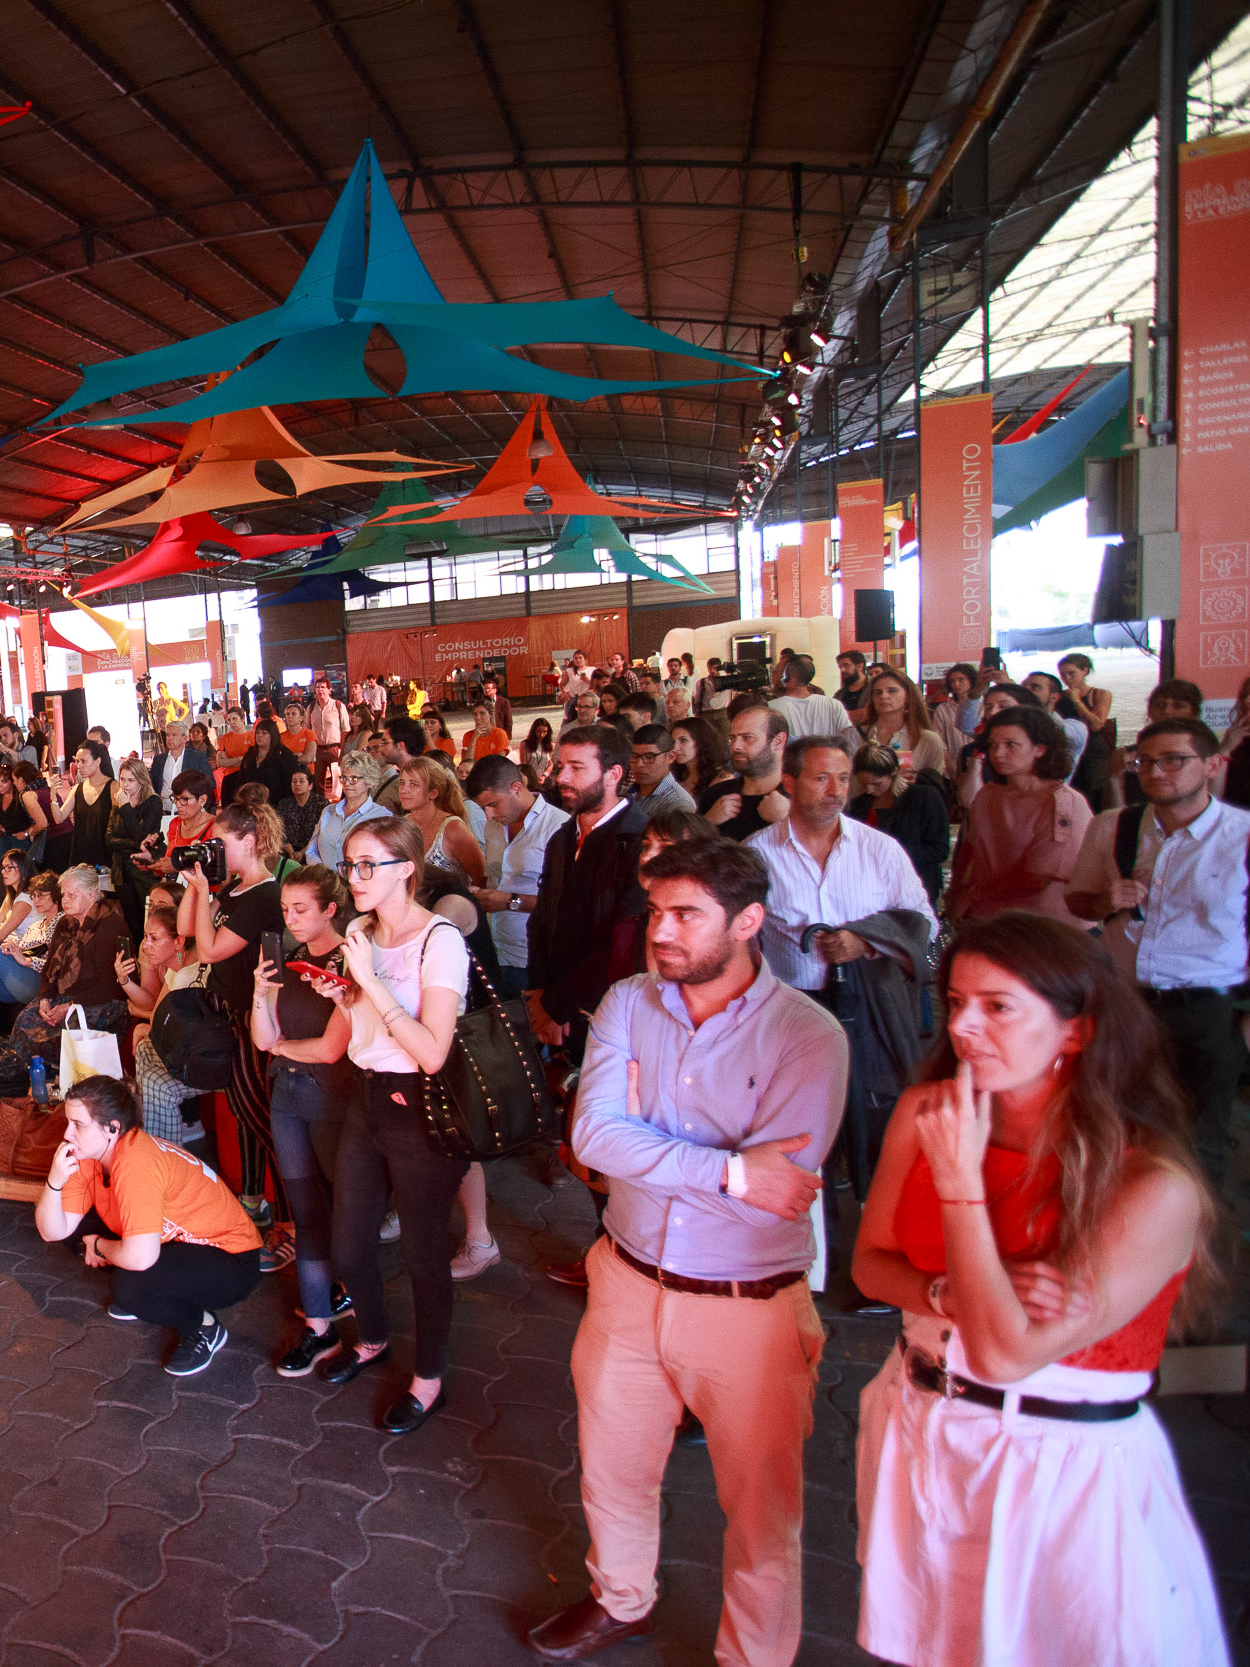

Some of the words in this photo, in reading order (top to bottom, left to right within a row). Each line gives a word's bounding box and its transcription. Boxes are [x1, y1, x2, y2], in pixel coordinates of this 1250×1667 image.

[1198, 371, 1234, 383] BAÑOS
[1196, 442, 1233, 453] SALIDA
[962, 443, 981, 626] FORTALECIMIENTO
[437, 636, 525, 652] CONSULTORIO
[434, 646, 529, 662] EMPRENDEDOR
